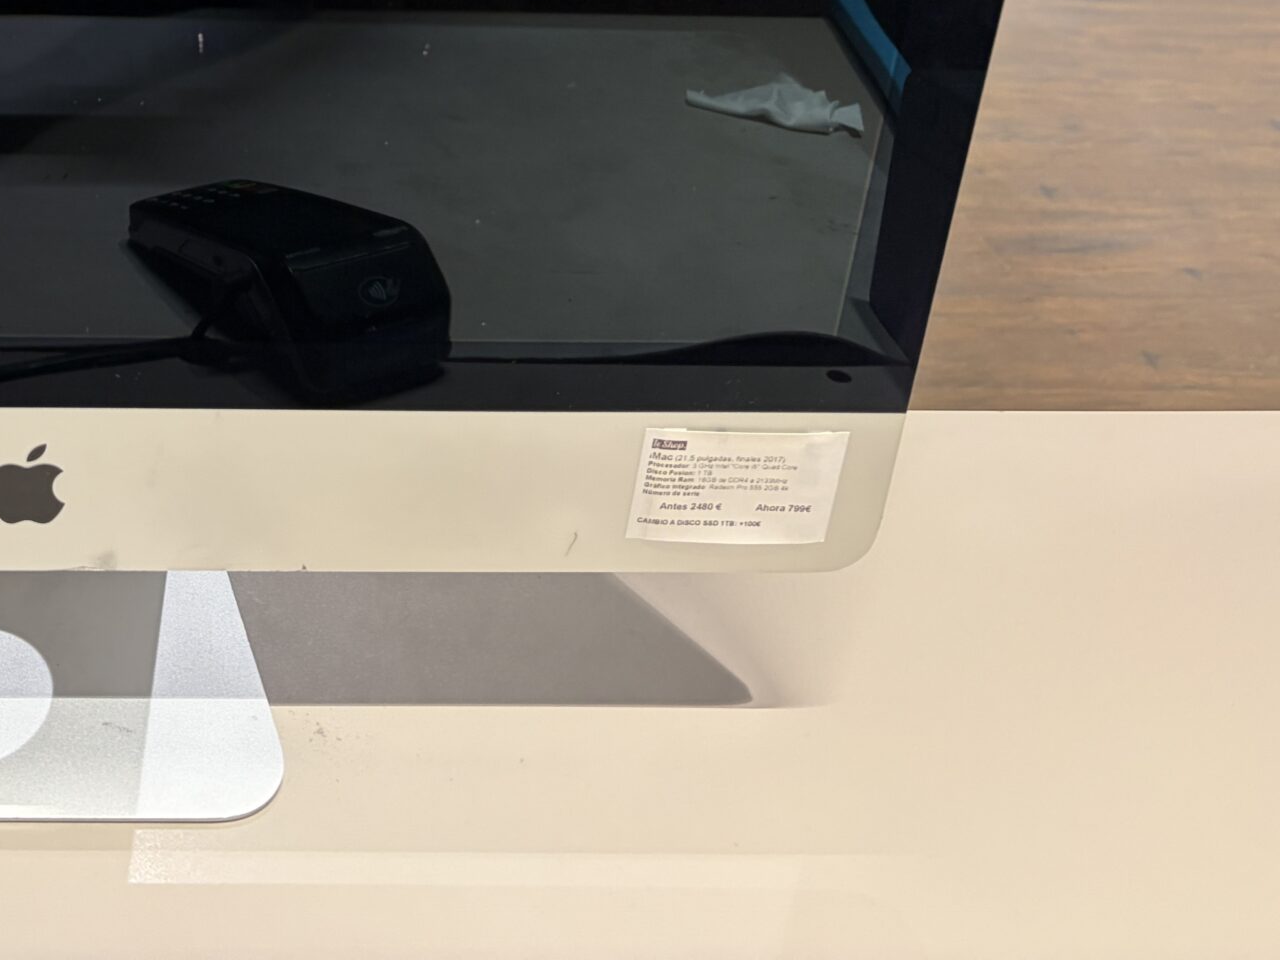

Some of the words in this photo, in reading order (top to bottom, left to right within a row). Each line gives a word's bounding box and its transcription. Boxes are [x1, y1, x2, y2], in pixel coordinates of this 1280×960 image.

[649, 451, 673, 461] iMac
[763, 455, 786, 463] 2017)
[646, 468, 669, 476] Disco
[659, 502, 688, 511] Antes
[690, 502, 715, 511] 2480
[715, 503, 723, 511] €
[755, 503, 786, 512] Ahora
[787, 504, 812, 513] 799€
[636, 516, 669, 526] CAMBIO
